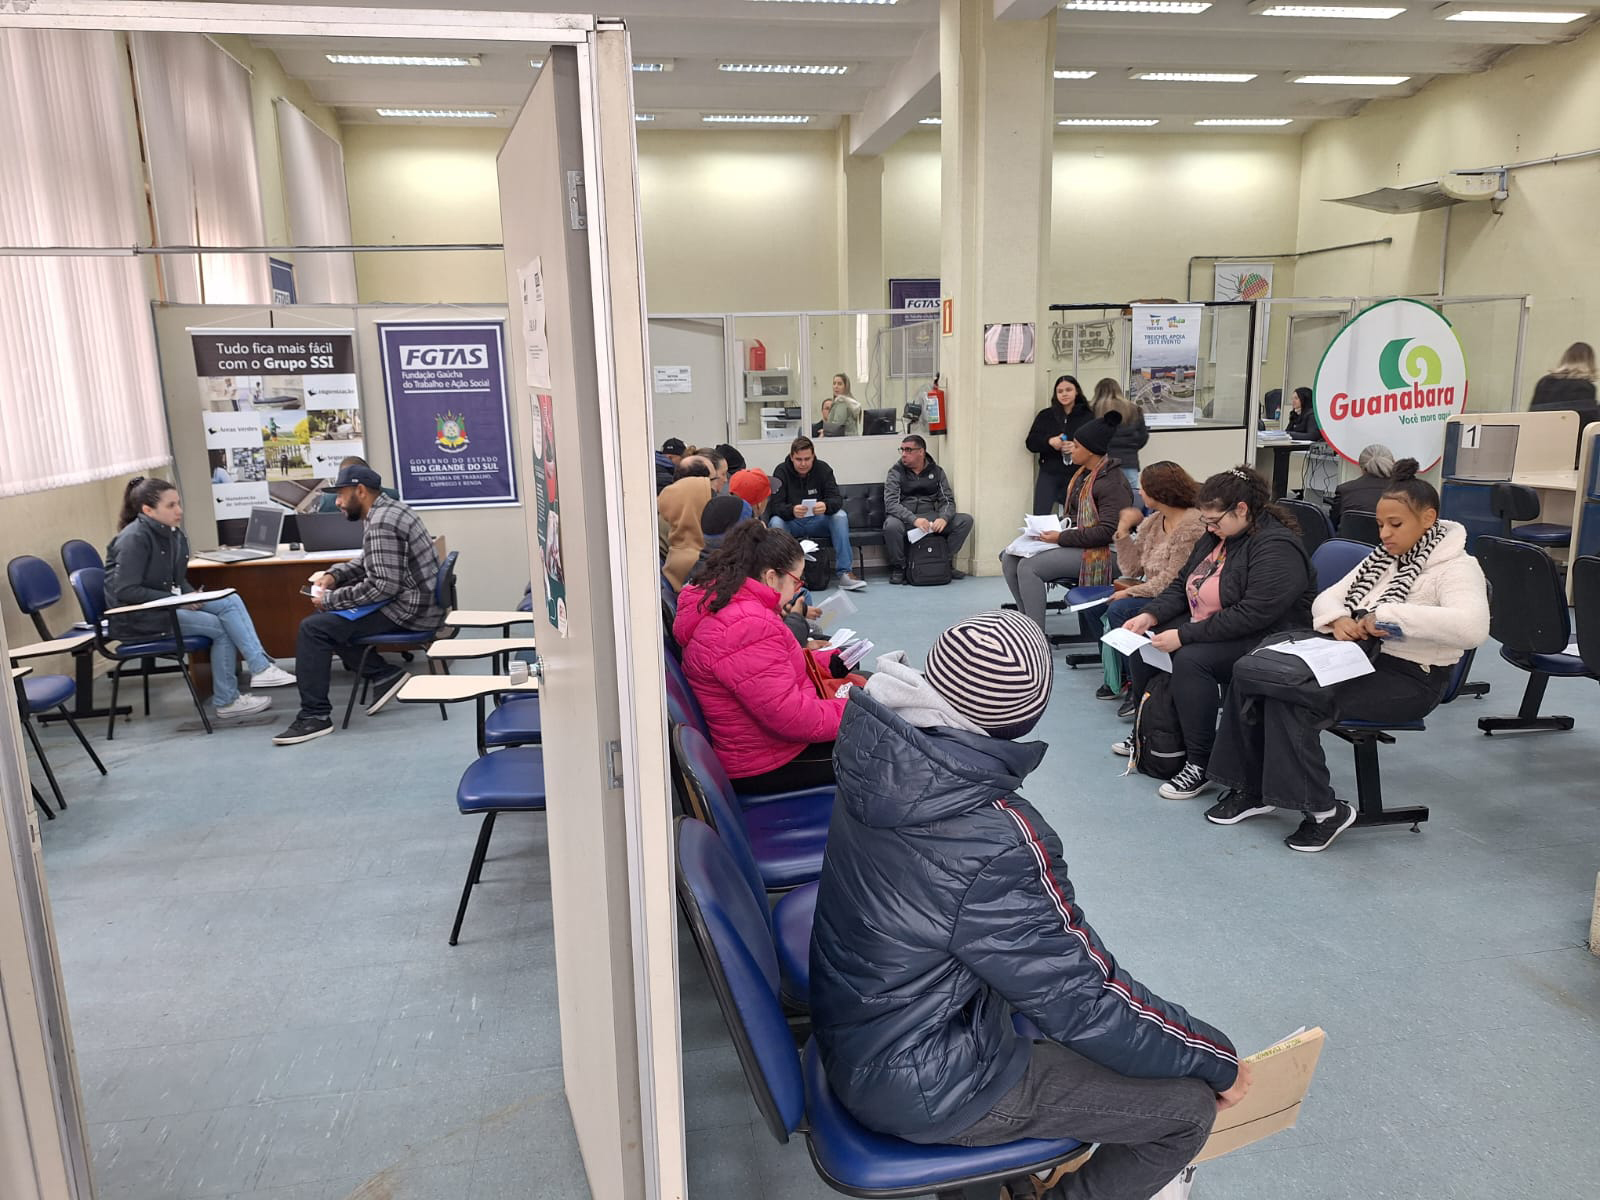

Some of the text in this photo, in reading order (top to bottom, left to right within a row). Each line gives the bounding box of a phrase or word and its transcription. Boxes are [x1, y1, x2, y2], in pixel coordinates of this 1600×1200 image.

[907, 299, 940, 308] FGTAS
[216, 342, 333, 354] Tudo fica mais fácil
[406, 348, 482, 366] FGTAS
[218, 356, 334, 371] com o Grupo SSI
[401, 370, 463, 380] Fundação Gaúcha
[402, 380, 414, 388] do
[414, 380, 444, 388] Trabalho
[451, 379, 469, 389] Ação
[470, 379, 490, 388] Social
[1329, 382, 1455, 421] Guanabara
[1398, 413, 1419, 425] Você
[1466, 425, 1476, 447] 1
[409, 457, 449, 465] GOVERNO
[410, 462, 499, 473] RIO GRANDE DO SUL
